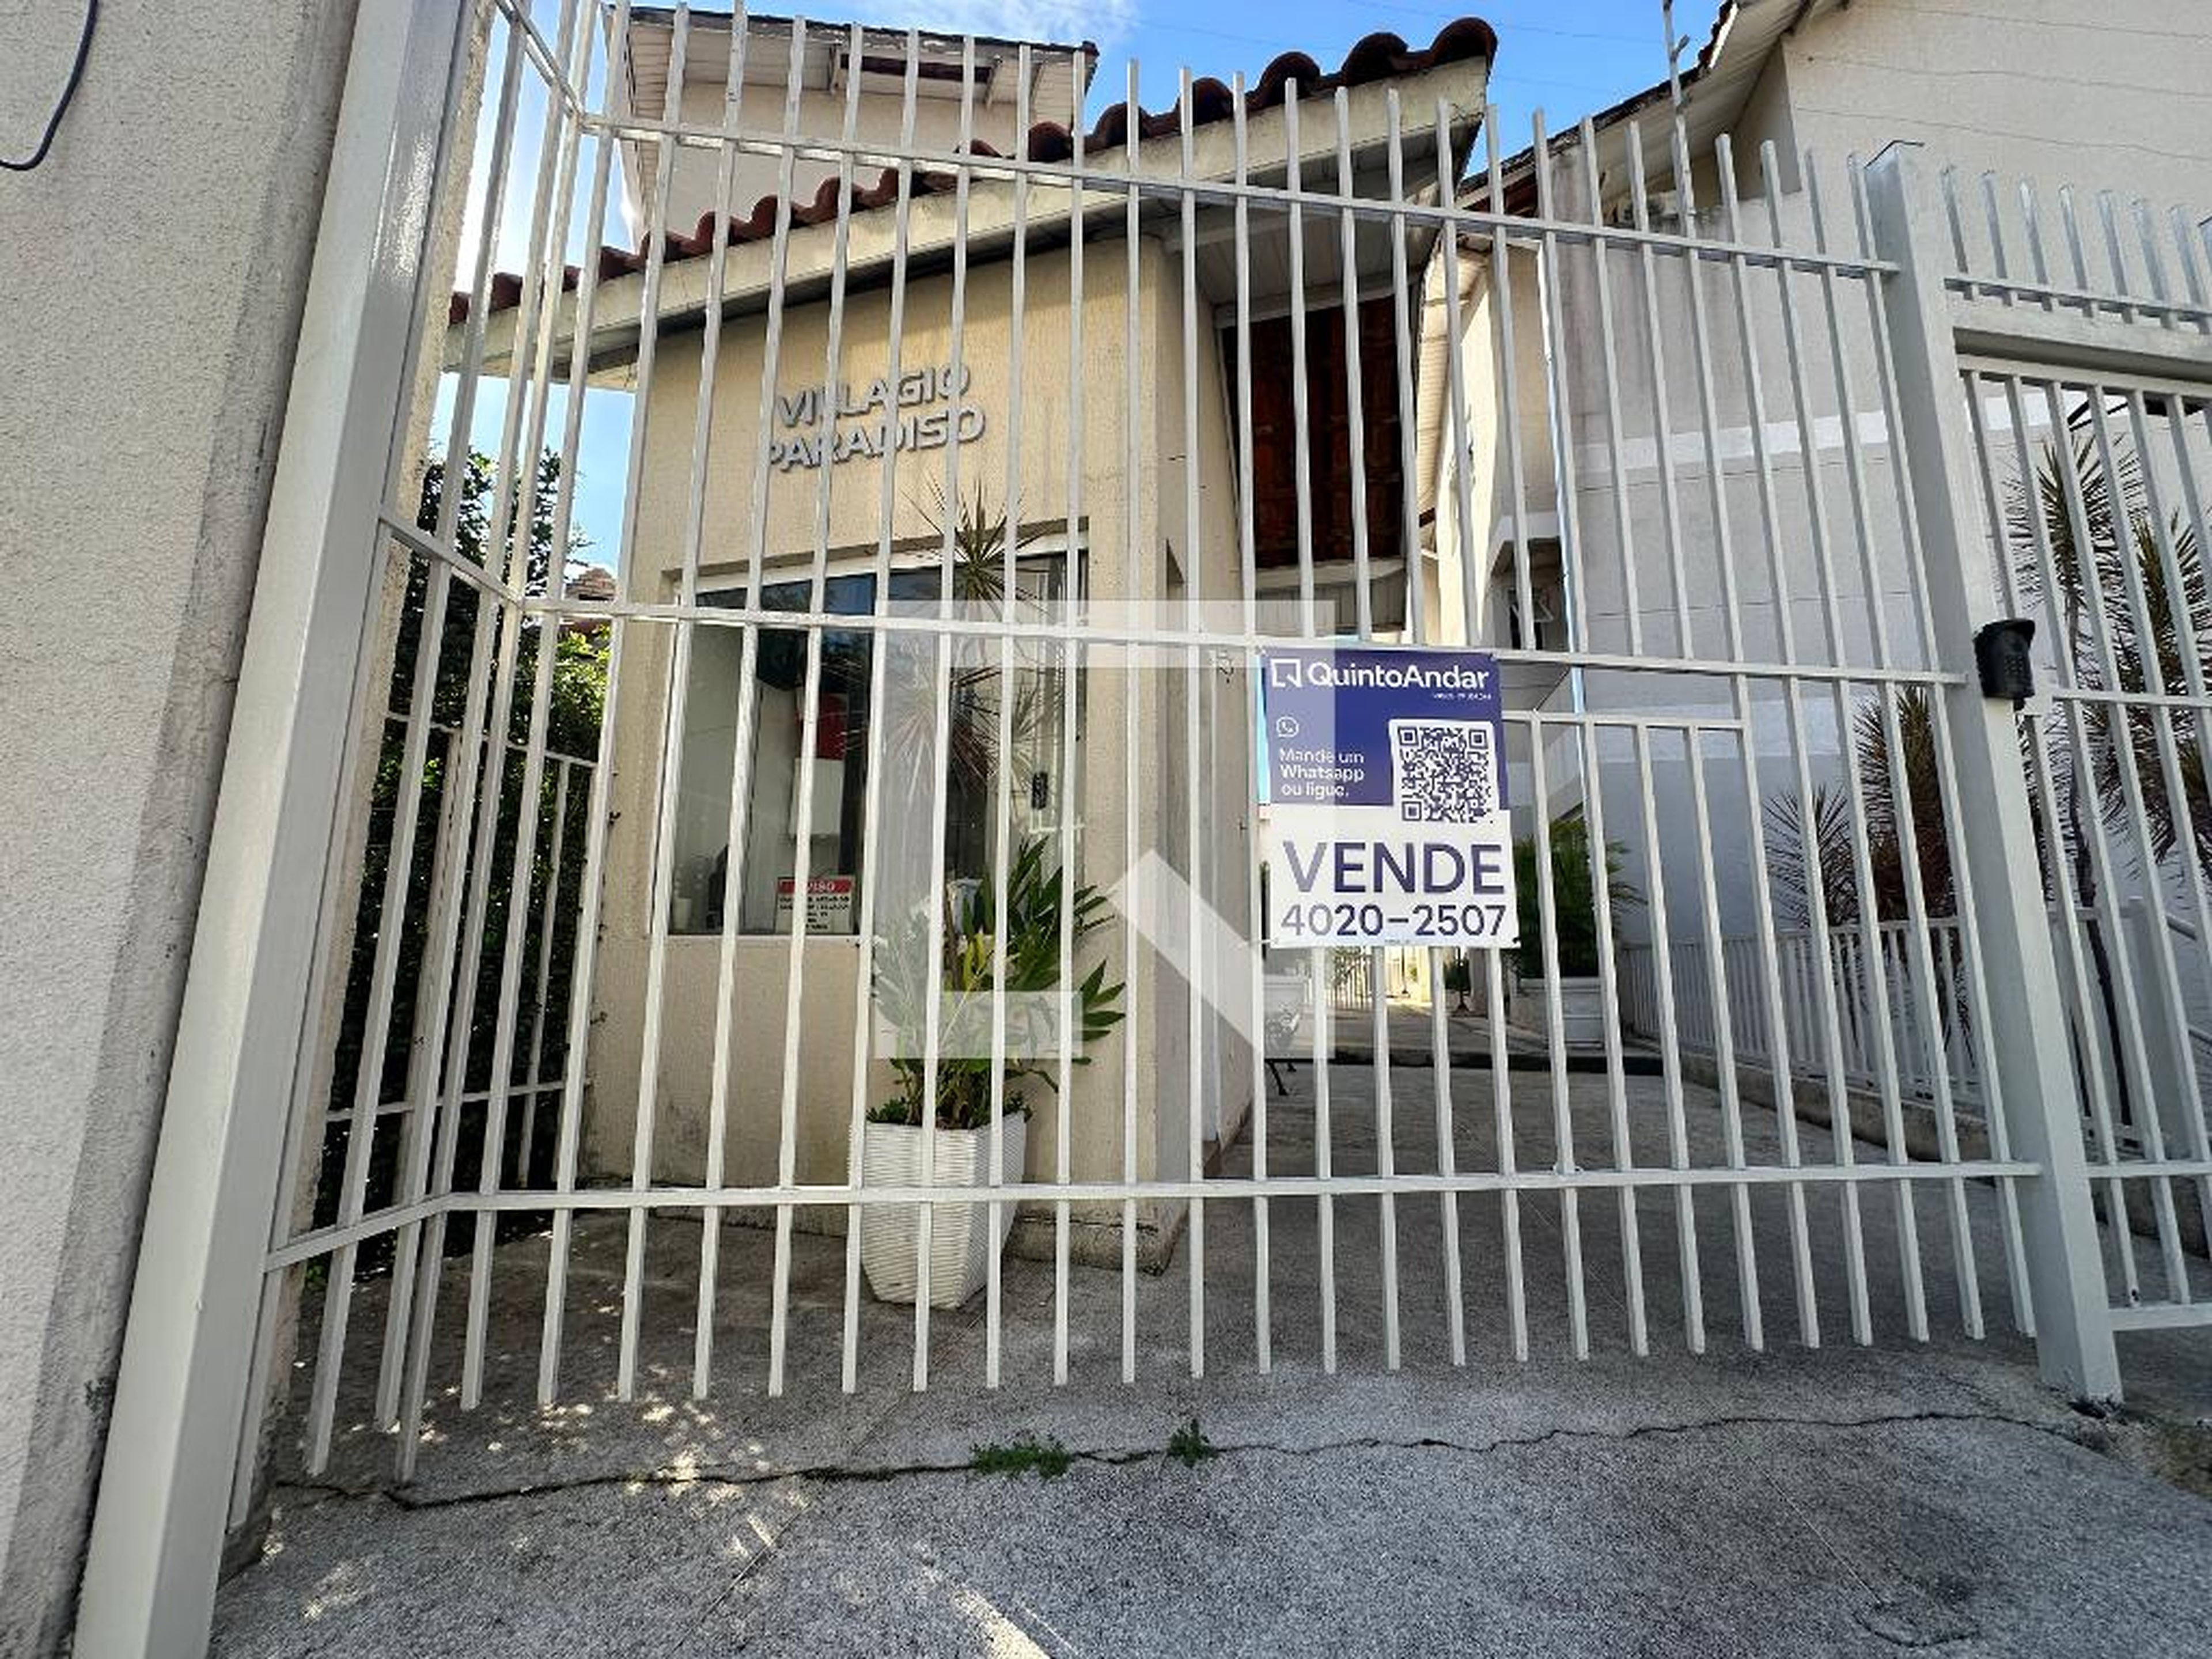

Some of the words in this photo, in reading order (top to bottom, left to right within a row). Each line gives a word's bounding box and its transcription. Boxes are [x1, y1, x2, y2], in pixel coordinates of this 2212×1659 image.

[1308, 661, 1490, 689] QuintoAndar
[1279, 748, 1335, 763] Mande
[1338, 752, 1365, 763] um
[1280, 764, 1365, 782] Whatsapp
[1281, 784, 1301, 796] ou
[1306, 781, 1349, 800] ligue.
[1282, 840, 1505, 895] VENDE
[1281, 903, 1506, 937] 4020-2507
